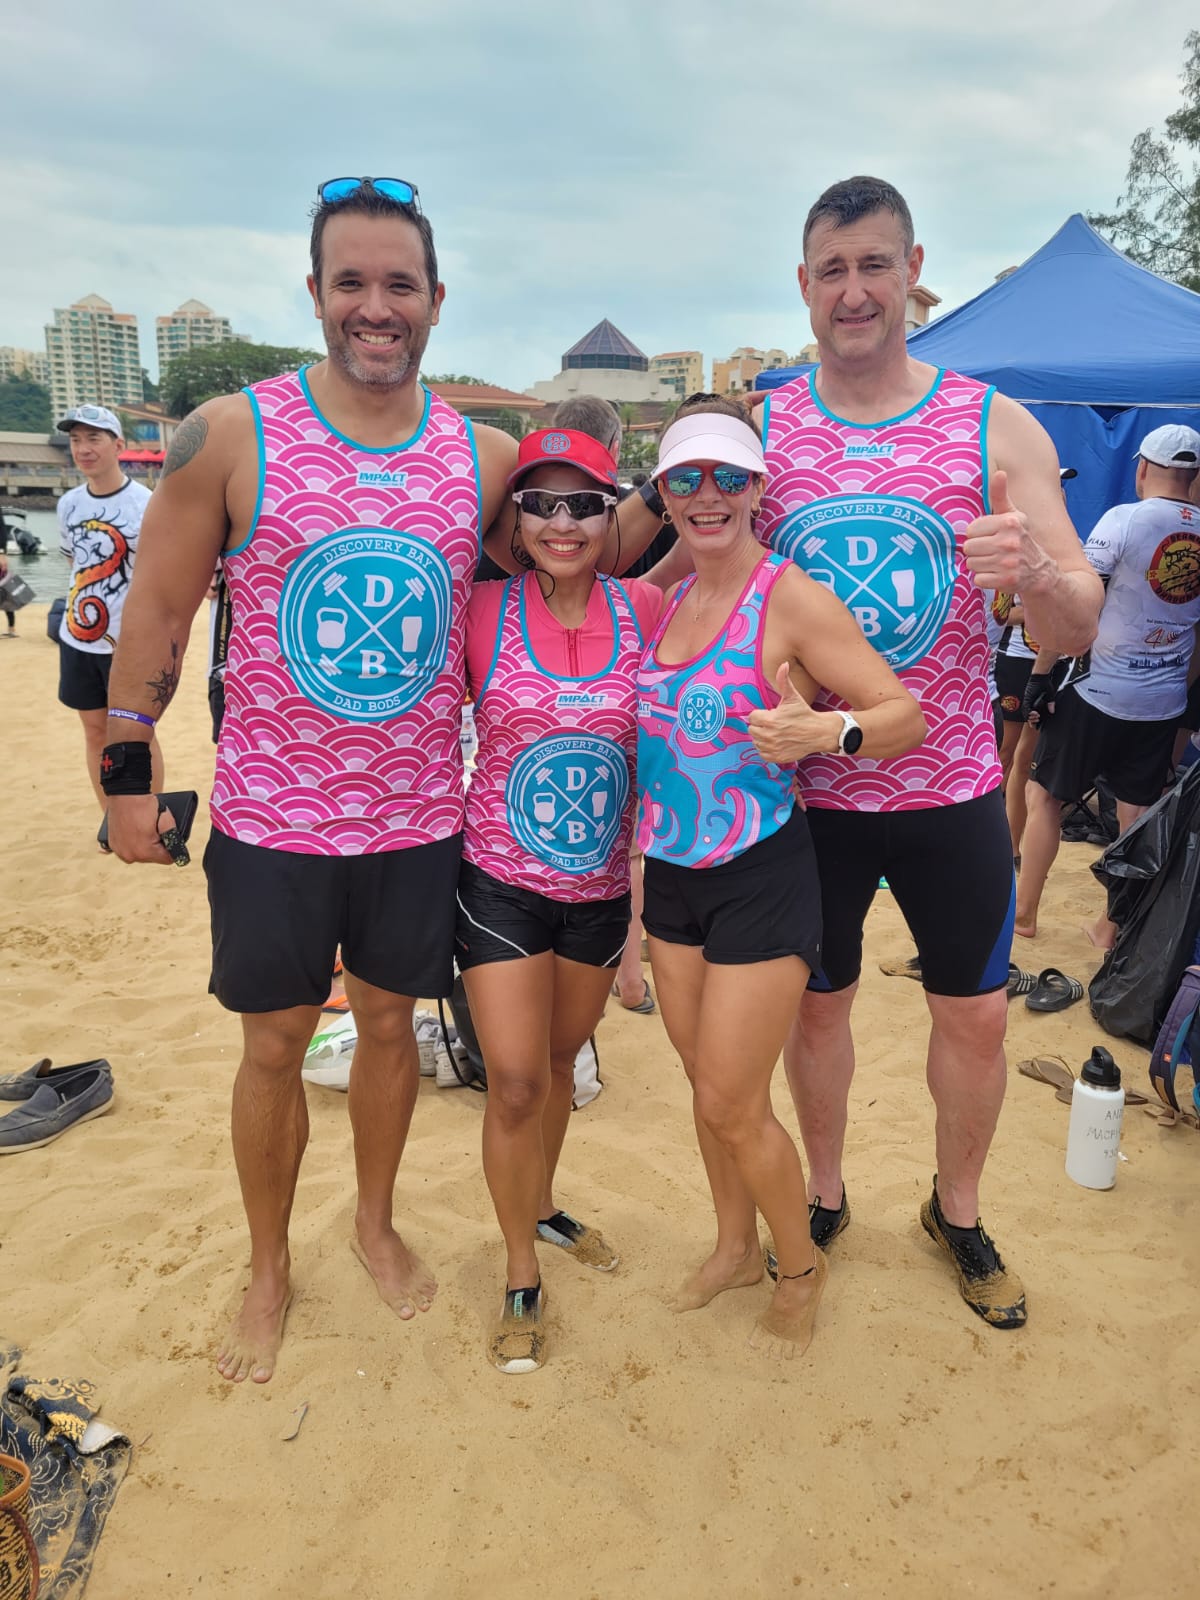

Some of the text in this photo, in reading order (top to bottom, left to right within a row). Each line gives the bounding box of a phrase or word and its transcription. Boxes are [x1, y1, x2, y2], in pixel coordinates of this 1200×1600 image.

[846, 444, 895, 454] IMPACT
[359, 471, 406, 482] IMPACT
[799, 503, 924, 529] DISCOVERY BAY
[322, 539, 433, 569] DISCOVERY BAY
[844, 536, 878, 567] D
[362, 574, 394, 607] D
[851, 606, 882, 637] B
[358, 649, 388, 680] B
[333, 694, 401, 712] DAD BODS
[558, 692, 606, 703] IMPACT
[696, 697, 704, 708] D
[694, 719, 702, 730] B
[534, 740, 616, 761] DISCOVERY BAY
[565, 766, 587, 791] D
[566, 820, 587, 844] B
[550, 854, 599, 867] DAD BODS
